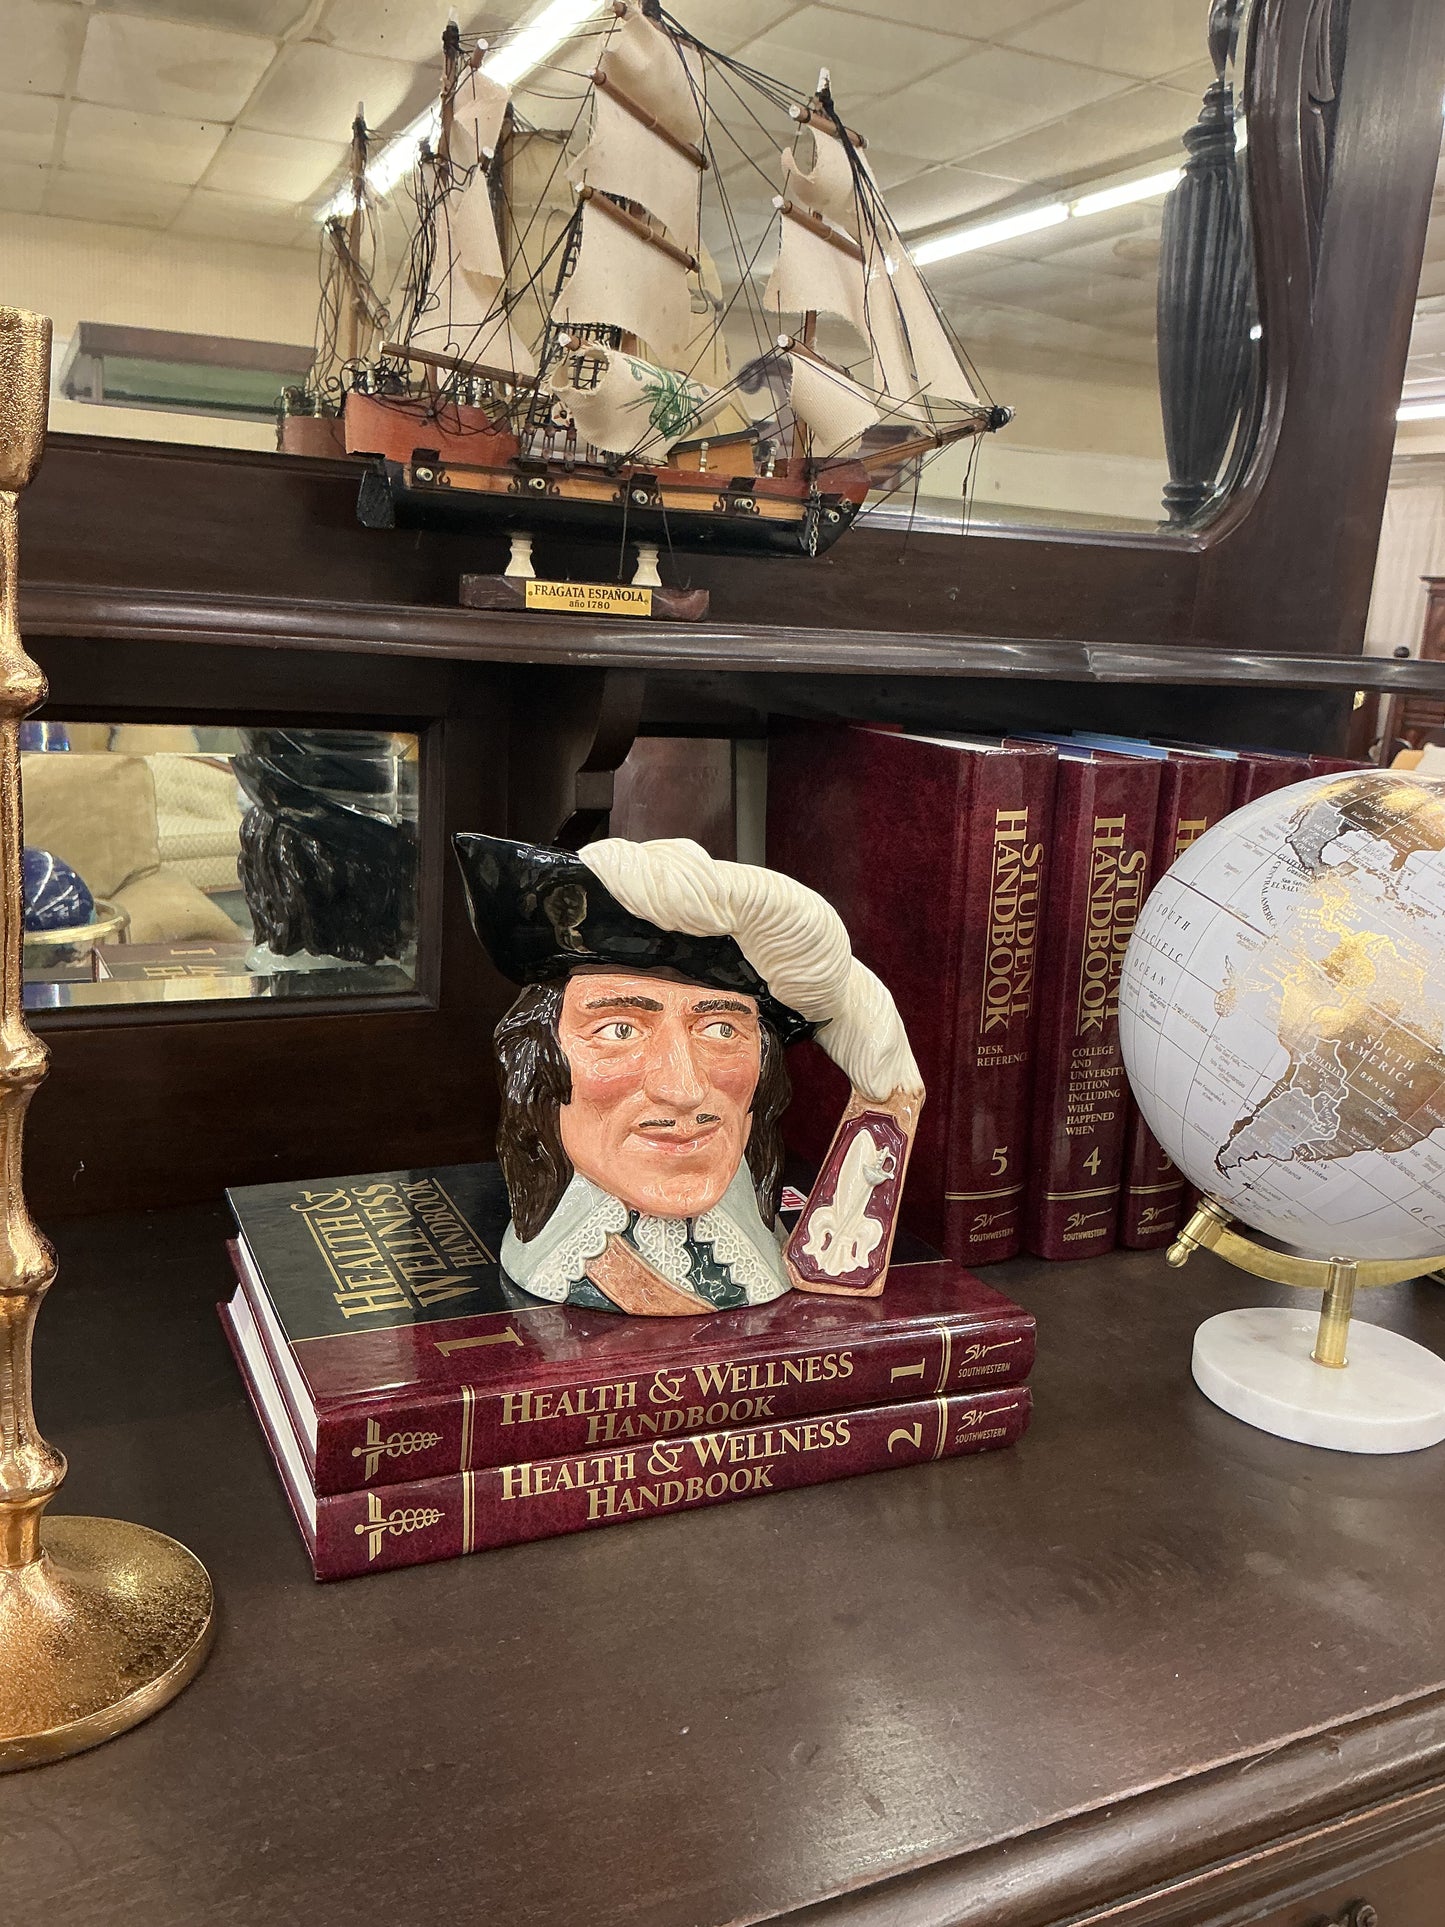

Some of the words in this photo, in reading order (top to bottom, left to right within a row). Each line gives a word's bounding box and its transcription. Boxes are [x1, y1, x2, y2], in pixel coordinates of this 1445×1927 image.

[534, 585, 585, 598] FRAGATA
[588, 588, 644, 602] ESPAÑOLA
[569, 600, 585, 608] año
[587, 601, 610, 610] 1780
[984, 806, 1029, 1033] HANDBOOK
[1011, 843, 1043, 1019] STUDENT
[1080, 814, 1127, 1036] HANDBOOK
[1156, 903, 1191, 931] SOUTH
[1140, 928, 1184, 963] PACIFIC
[1133, 958, 1166, 986] OCEAN
[977, 1045, 1003, 1055] DESK
[1070, 1058, 1091, 1069] AND
[1072, 1045, 1114, 1058] COLLEGE
[1310, 1052, 1341, 1076] BOLIVIA
[1364, 1033, 1415, 1071] SOUTH
[1070, 1067, 1125, 1080] UNIVERSITY
[1345, 1041, 1414, 1089] AMERICA
[1068, 1089, 1121, 1102] INCLUDING
[1069, 1079, 1110, 1091] EDITION
[1360, 1071, 1396, 1100] BRAZIL
[1066, 1112, 1115, 1125] HAPPENED
[1067, 1103, 1095, 1113] WHAT
[1065, 1125, 1095, 1136] WHEN
[990, 1146, 1008, 1176] 5
[1082, 1146, 1101, 1176] 4
[290, 1188, 352, 1213] &
[399, 1178, 489, 1269] HANDBOOK
[969, 1227, 1014, 1243] SOUTHWESTERN
[1063, 1228, 1107, 1242] SOUTHWESTERN
[351, 1183, 481, 1307] WELLNESS
[315, 1213, 413, 1319] HEALTH
[433, 1327, 524, 1357] 1
[890, 1357, 926, 1383] 1
[958, 1362, 1011, 1378] SOUTHWESTERN
[500, 1381, 638, 1426] HEALTH
[648, 1369, 686, 1405] &
[692, 1351, 853, 1397] WELLNESS
[585, 1395, 775, 1445] HANDBOOK
[887, 1422, 922, 1453] 2
[955, 1427, 1007, 1445] SOUTHWESTERN
[499, 1452, 636, 1501] HEALTH
[647, 1439, 684, 1476] &
[689, 1419, 851, 1468] WELLNESS
[586, 1464, 774, 1521] HANDBOOK
